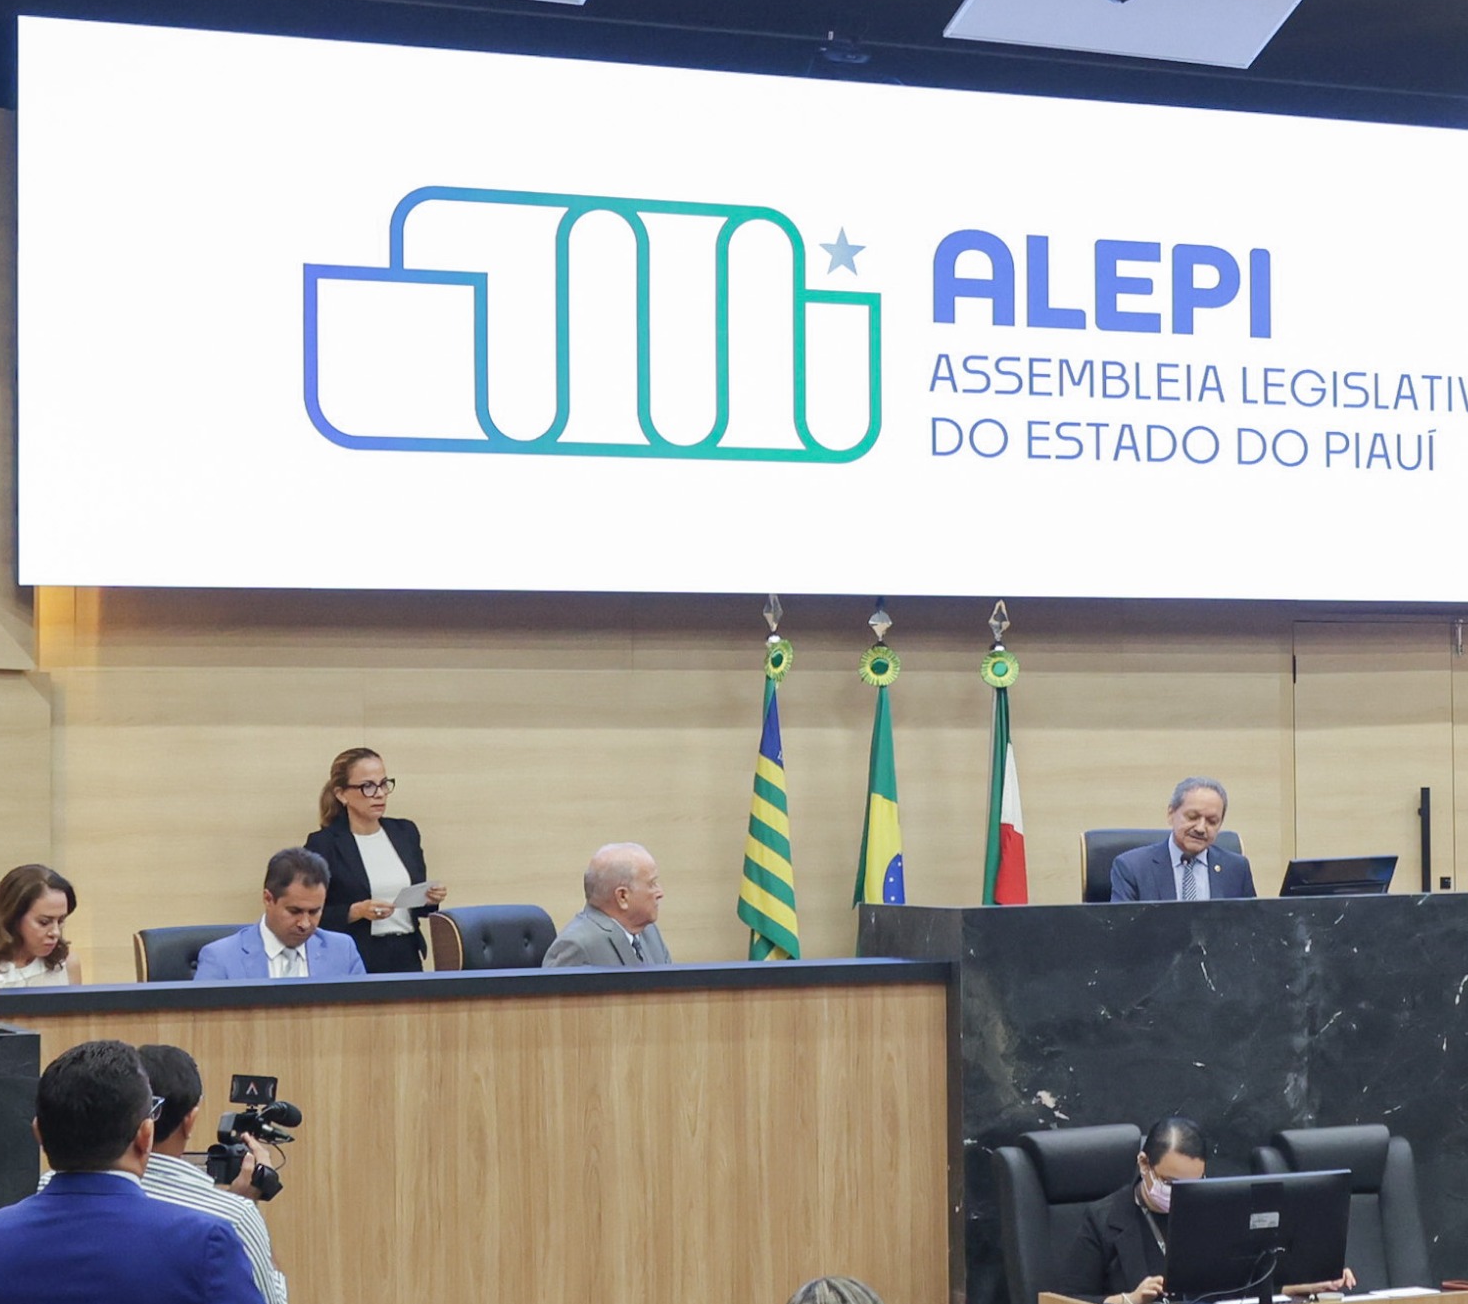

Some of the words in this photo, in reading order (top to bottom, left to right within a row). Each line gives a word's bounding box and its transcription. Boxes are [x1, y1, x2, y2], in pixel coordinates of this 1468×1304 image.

[932, 229, 1272, 340] ALEPI
[929, 353, 1226, 403] ASSEMBLEIA
[931, 416, 1009, 459] DO
[1027, 420, 1220, 465] ESTADO
[1236, 427, 1309, 468] DO
[1325, 428, 1437, 472] PIAUÍ
